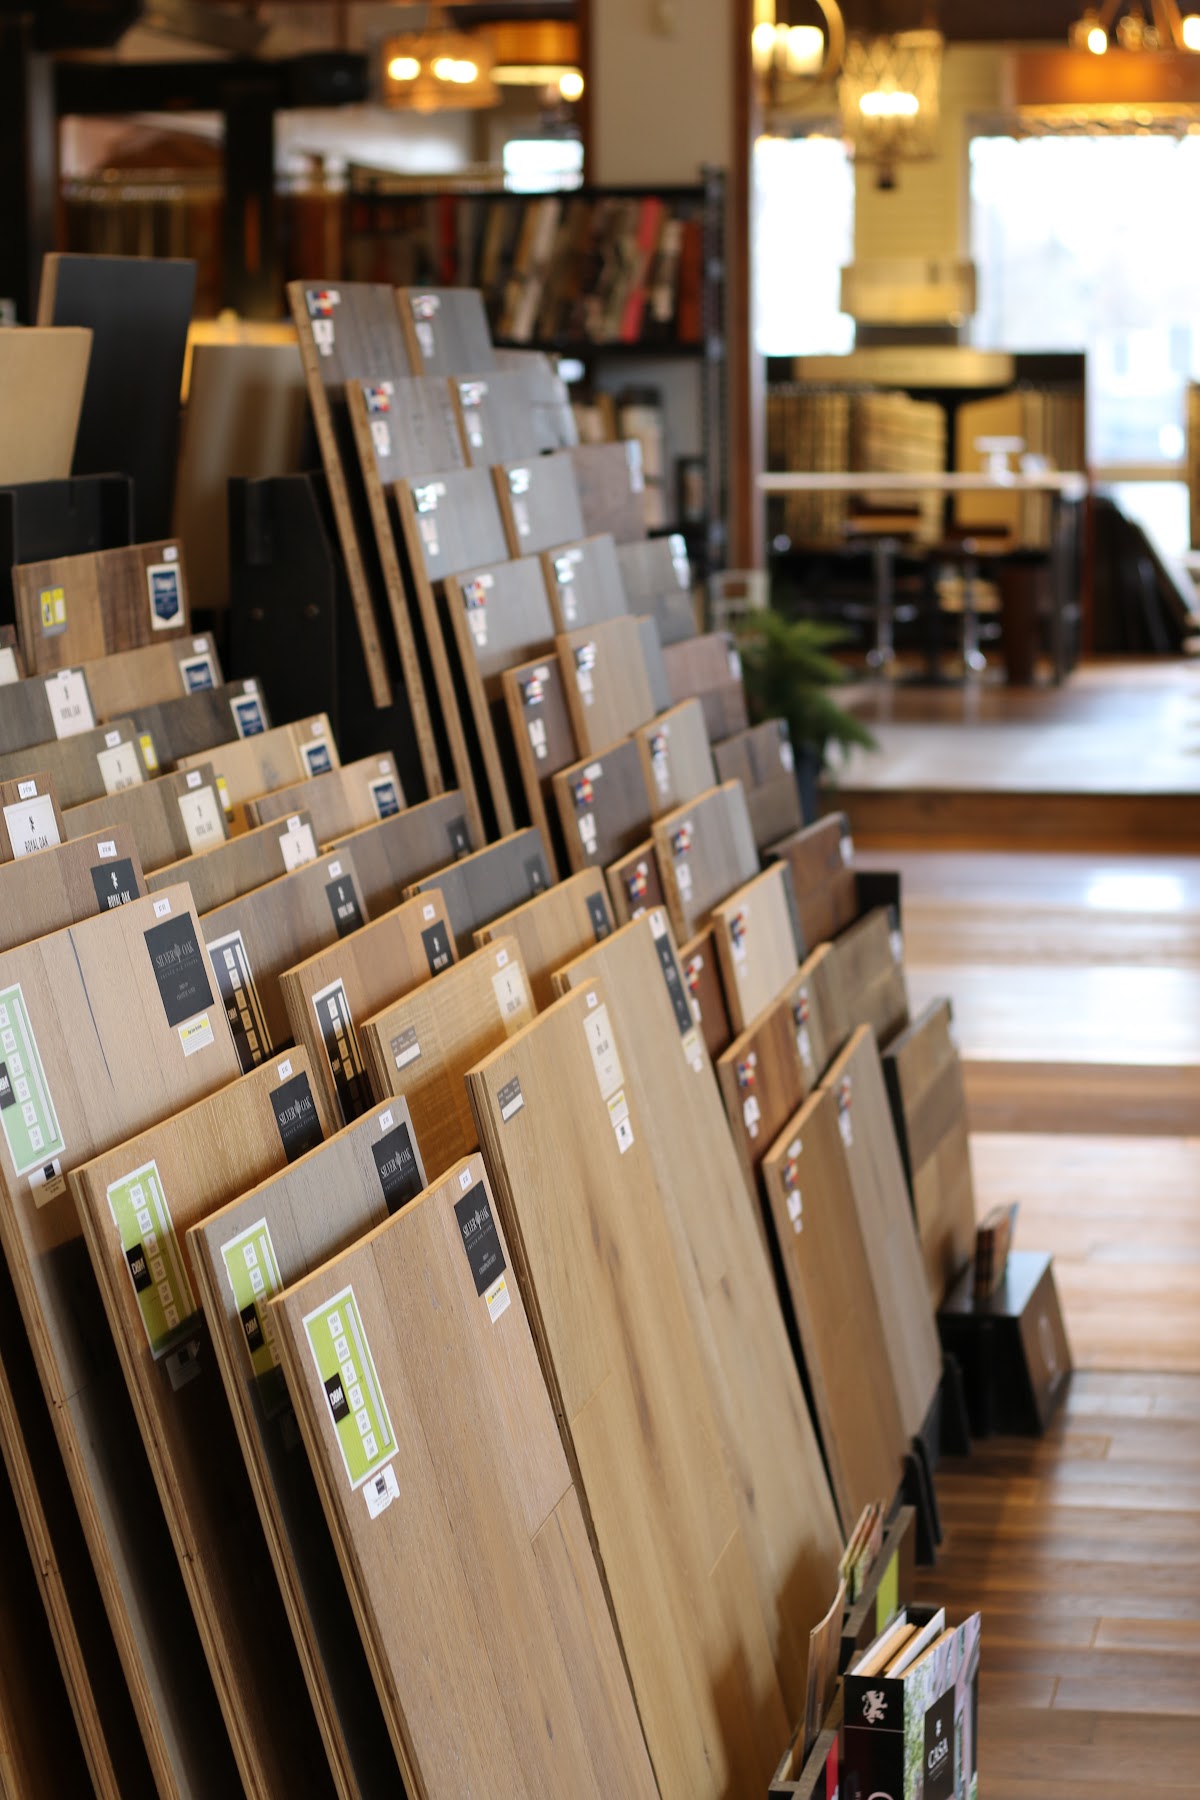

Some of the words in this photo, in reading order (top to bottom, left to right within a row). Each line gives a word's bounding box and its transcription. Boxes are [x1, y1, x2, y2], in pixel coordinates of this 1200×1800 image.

[24, 838, 38, 853] ROYAL
[39, 835, 49, 849] OAK
[107, 892, 121, 908] ROYAL
[121, 890, 131, 904] OAK
[155, 949, 175, 968] SILVER
[182, 940, 194, 955] OAK
[278, 1107, 296, 1127] SILVER
[300, 1095, 312, 1110] OAK
[380, 1159, 397, 1180] SILVER
[400, 1147, 411, 1162] OAK
[131, 1257, 146, 1275] D&M
[329, 1386, 344, 1406] D&M
[928, 1737, 949, 1769] CASA
